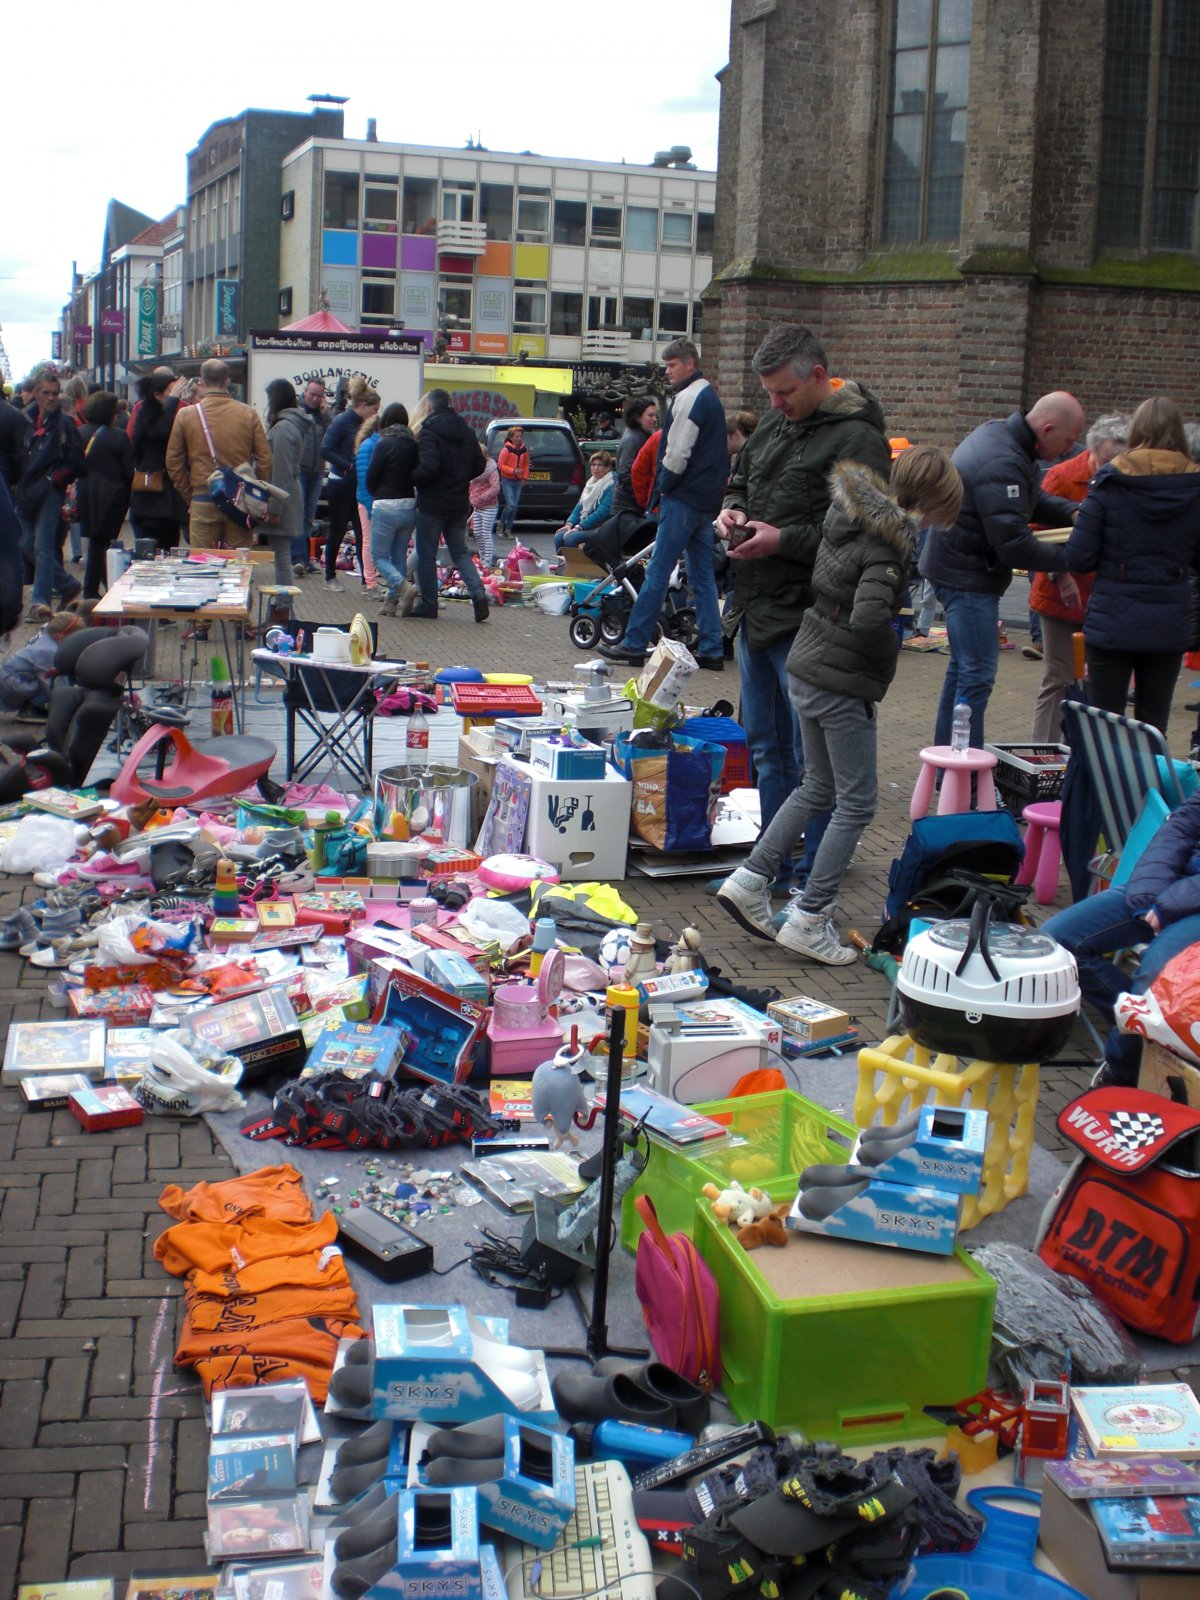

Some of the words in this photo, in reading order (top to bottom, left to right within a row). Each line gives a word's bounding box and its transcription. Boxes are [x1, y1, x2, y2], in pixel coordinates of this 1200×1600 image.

[1067, 1106, 1146, 1167] WÜRTH
[921, 1161, 968, 1176] SKYS
[880, 1213, 936, 1231] SKYS
[1066, 1207, 1168, 1288] DTM
[393, 1385, 454, 1399] SKYS
[559, 1454, 568, 1481] SKYS
[459, 1508, 469, 1535] SKYS
[499, 1500, 550, 1527] SKYS
[407, 1580, 464, 1592] SKYS
[483, 1568, 500, 1597] SKYS
